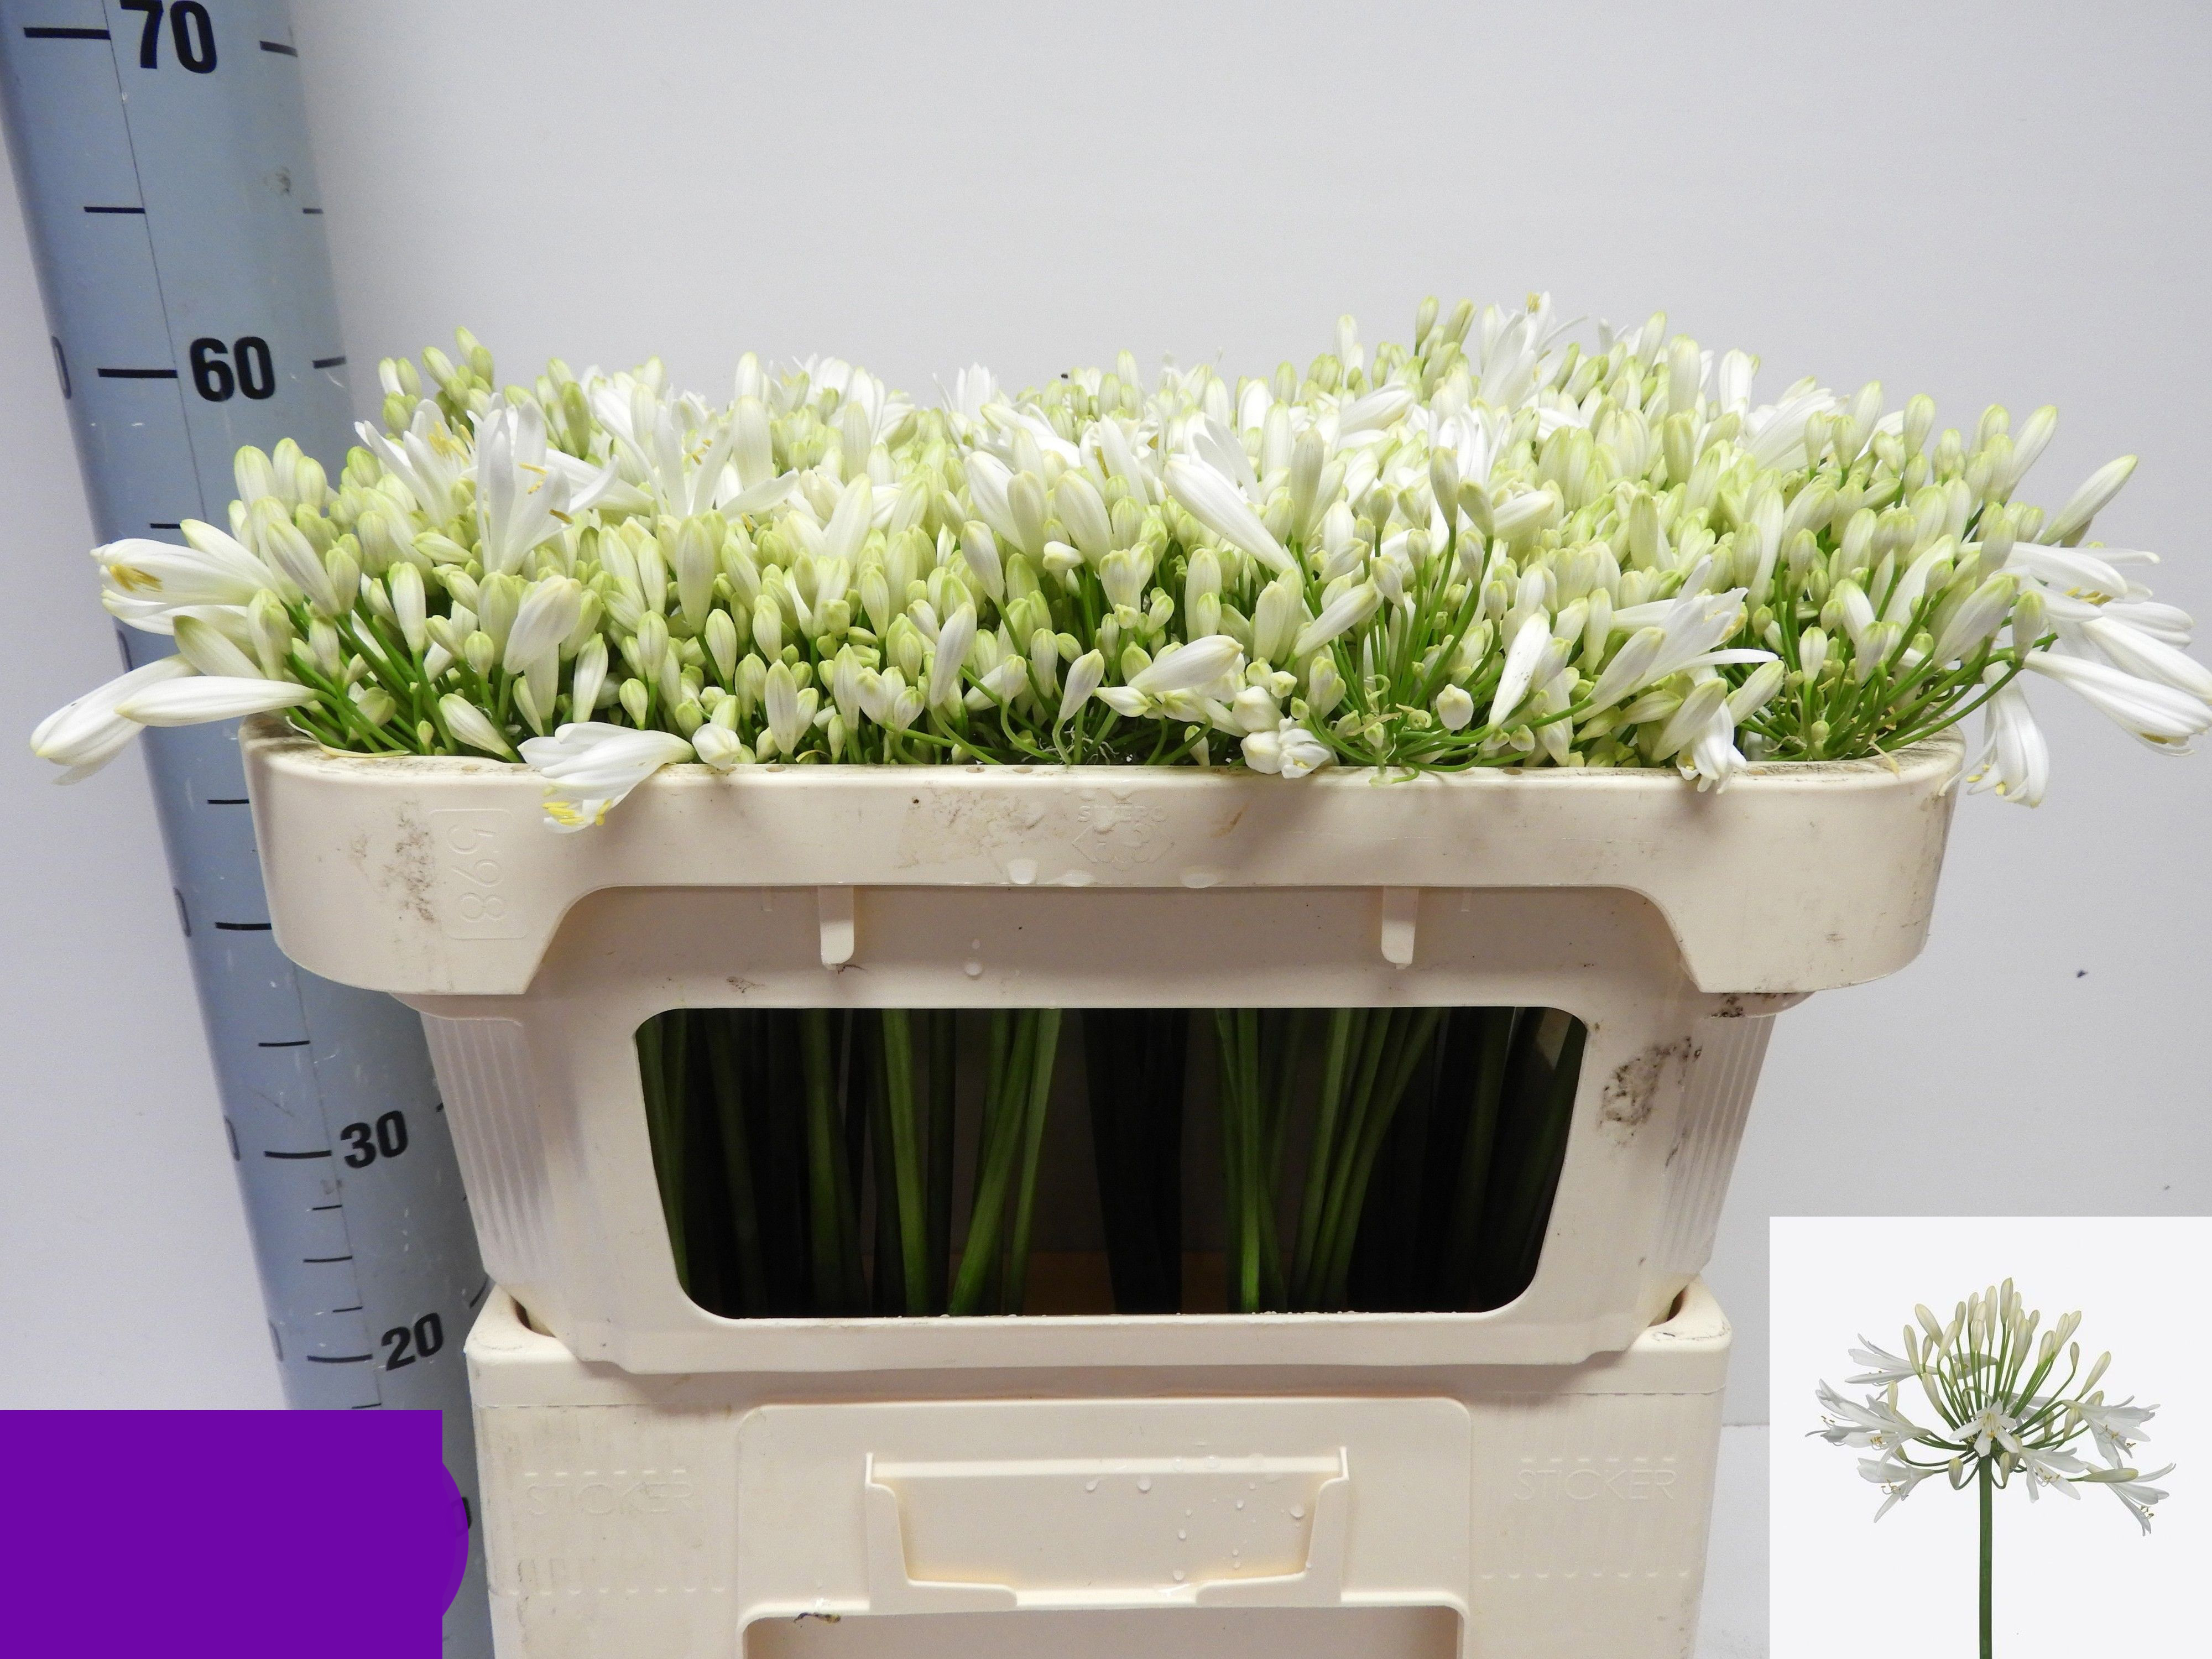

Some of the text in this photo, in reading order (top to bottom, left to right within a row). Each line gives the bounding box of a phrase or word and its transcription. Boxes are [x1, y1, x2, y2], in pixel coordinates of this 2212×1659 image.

[120, 0, 217, 74] 70
[190, 336, 275, 402] 60
[447, 824, 507, 923] 598
[340, 1110, 408, 1168] 30
[380, 1312, 444, 1371] 20
[1513, 1469, 1677, 1501] STICKER
